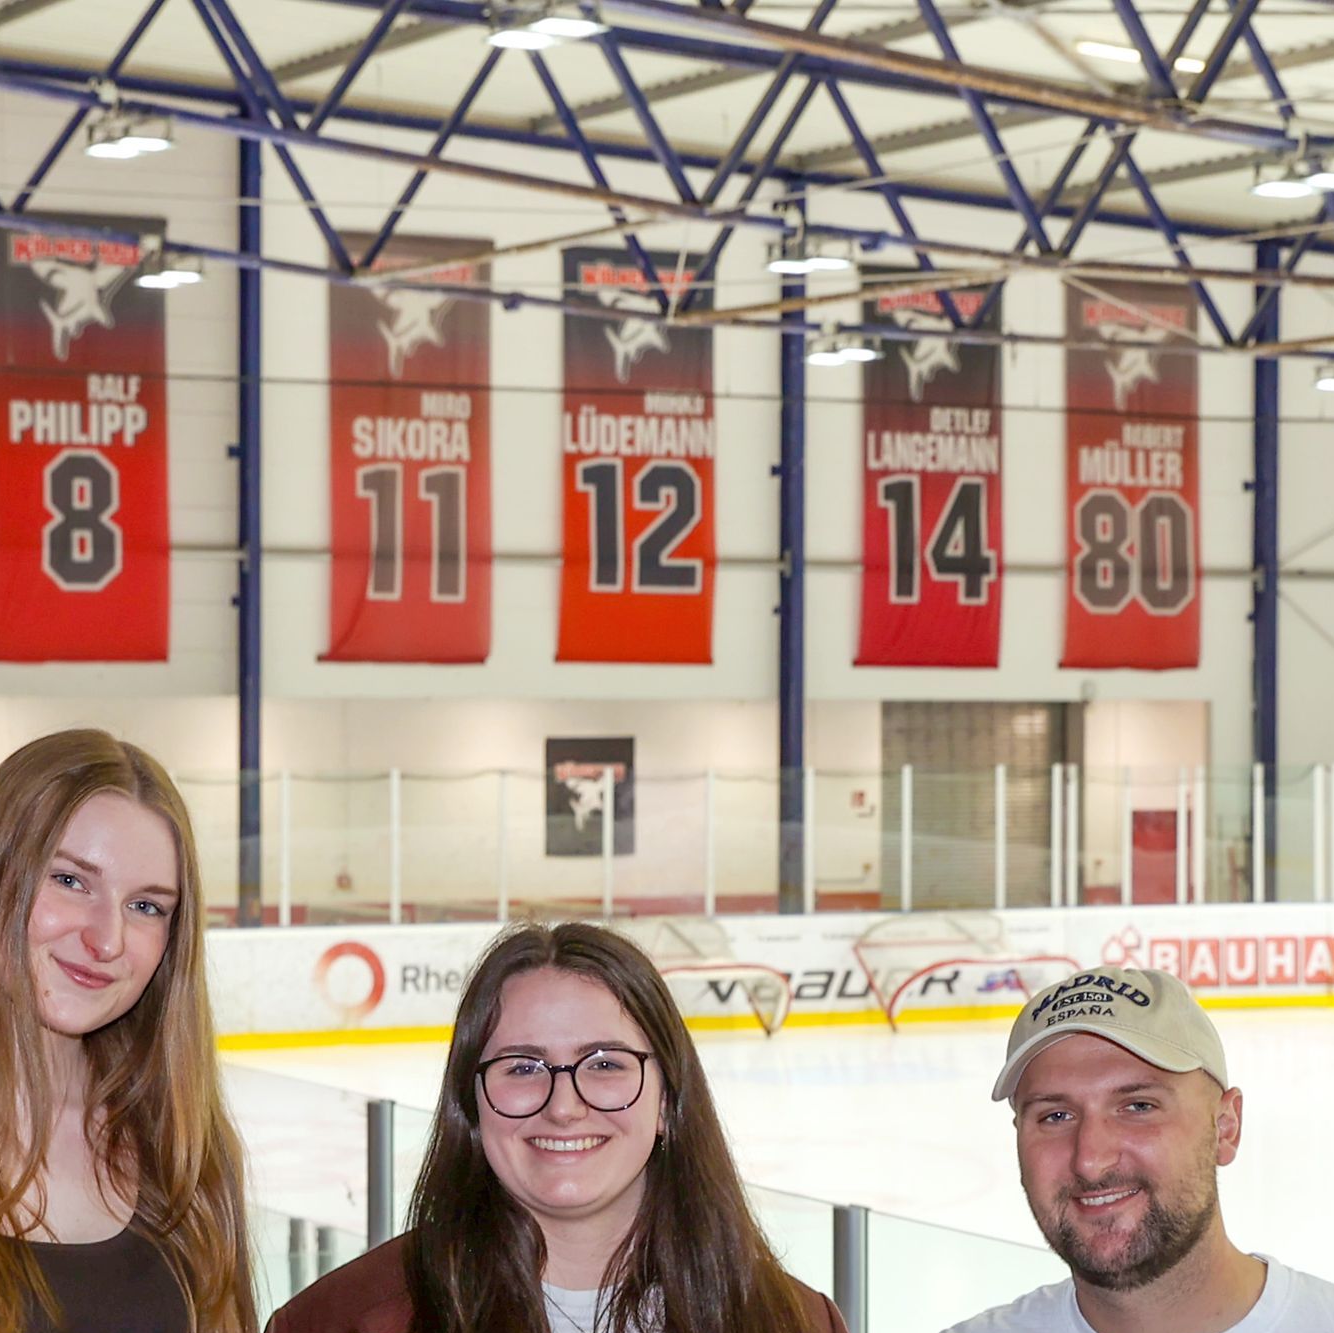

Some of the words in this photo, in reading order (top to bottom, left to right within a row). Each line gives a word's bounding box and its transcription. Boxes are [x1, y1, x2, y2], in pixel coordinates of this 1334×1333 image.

[87, 374, 141, 402] RALF
[420, 392, 472, 419] MIRO
[8, 399, 148, 446] PHILIPP
[352, 417, 471, 462] SIKORA
[563, 405, 714, 458] LÜDEMANN
[868, 430, 1000, 474] LANGEMANN
[1078, 440, 1183, 488] MÜLLER
[42, 448, 123, 592] 8
[356, 462, 466, 602] 11
[575, 457, 703, 594] 12
[877, 474, 997, 606] 14
[1073, 488, 1196, 616] 80
[1031, 974, 1151, 1022] MADRID
[1046, 1004, 1116, 1027] ESPAÑA
